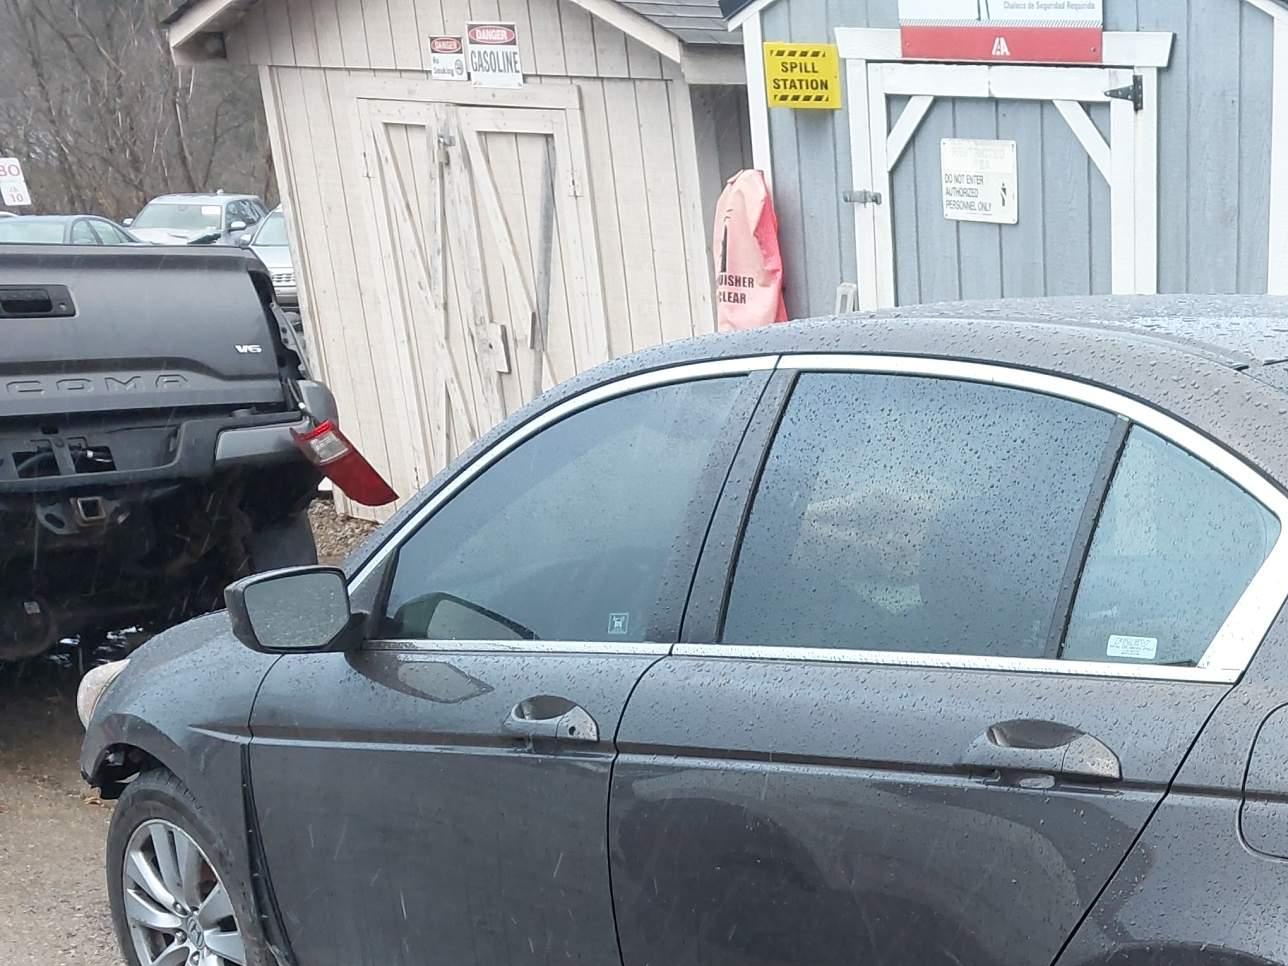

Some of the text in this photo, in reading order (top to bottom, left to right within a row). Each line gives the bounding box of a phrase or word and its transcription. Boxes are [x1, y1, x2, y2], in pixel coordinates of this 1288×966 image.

[475, 29, 508, 40] DANGER
[470, 50, 520, 74] GASOLINE
[781, 61, 819, 73] SPILL
[772, 78, 829, 90] STATION
[944, 173, 984, 185] DO NOT ENTER
[945, 186, 978, 198] AUTHORIZED
[945, 199, 992, 212] PERSONNEL ONLY
[235, 344, 262, 353] V6
